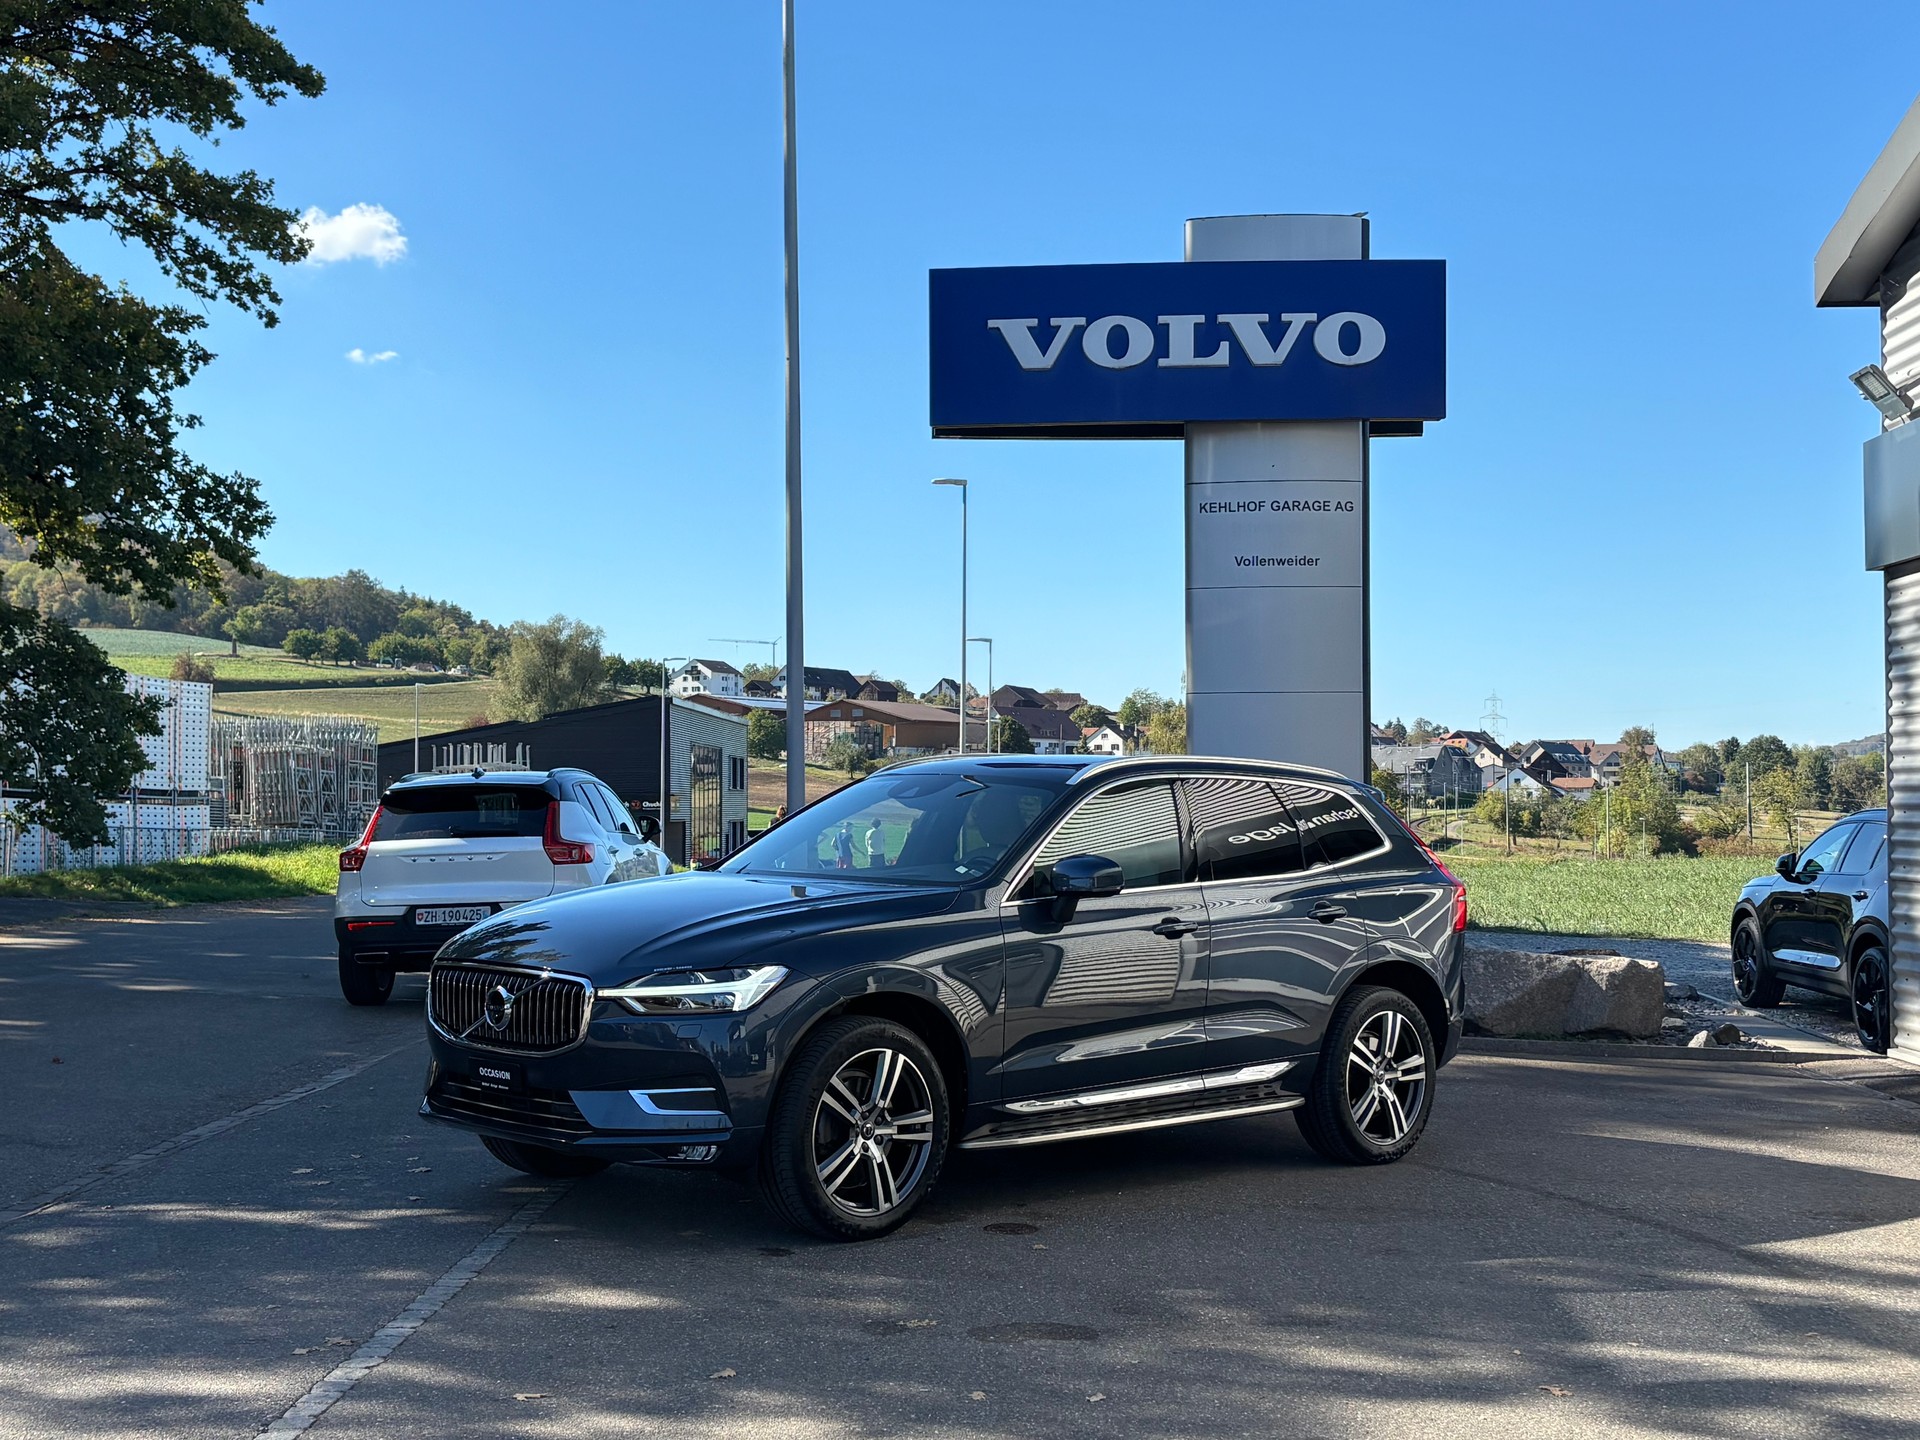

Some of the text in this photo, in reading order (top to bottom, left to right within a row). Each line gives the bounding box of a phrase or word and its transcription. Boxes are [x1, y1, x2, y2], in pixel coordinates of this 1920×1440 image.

[987, 311, 1386, 371] VOLVO
[1199, 500, 1354, 514] KEHLHOF GARAGE AG
[1234, 555, 1320, 567] Vollenweider
[424, 911, 438, 922] ZH
[479, 1066, 511, 1080] OCCASION
